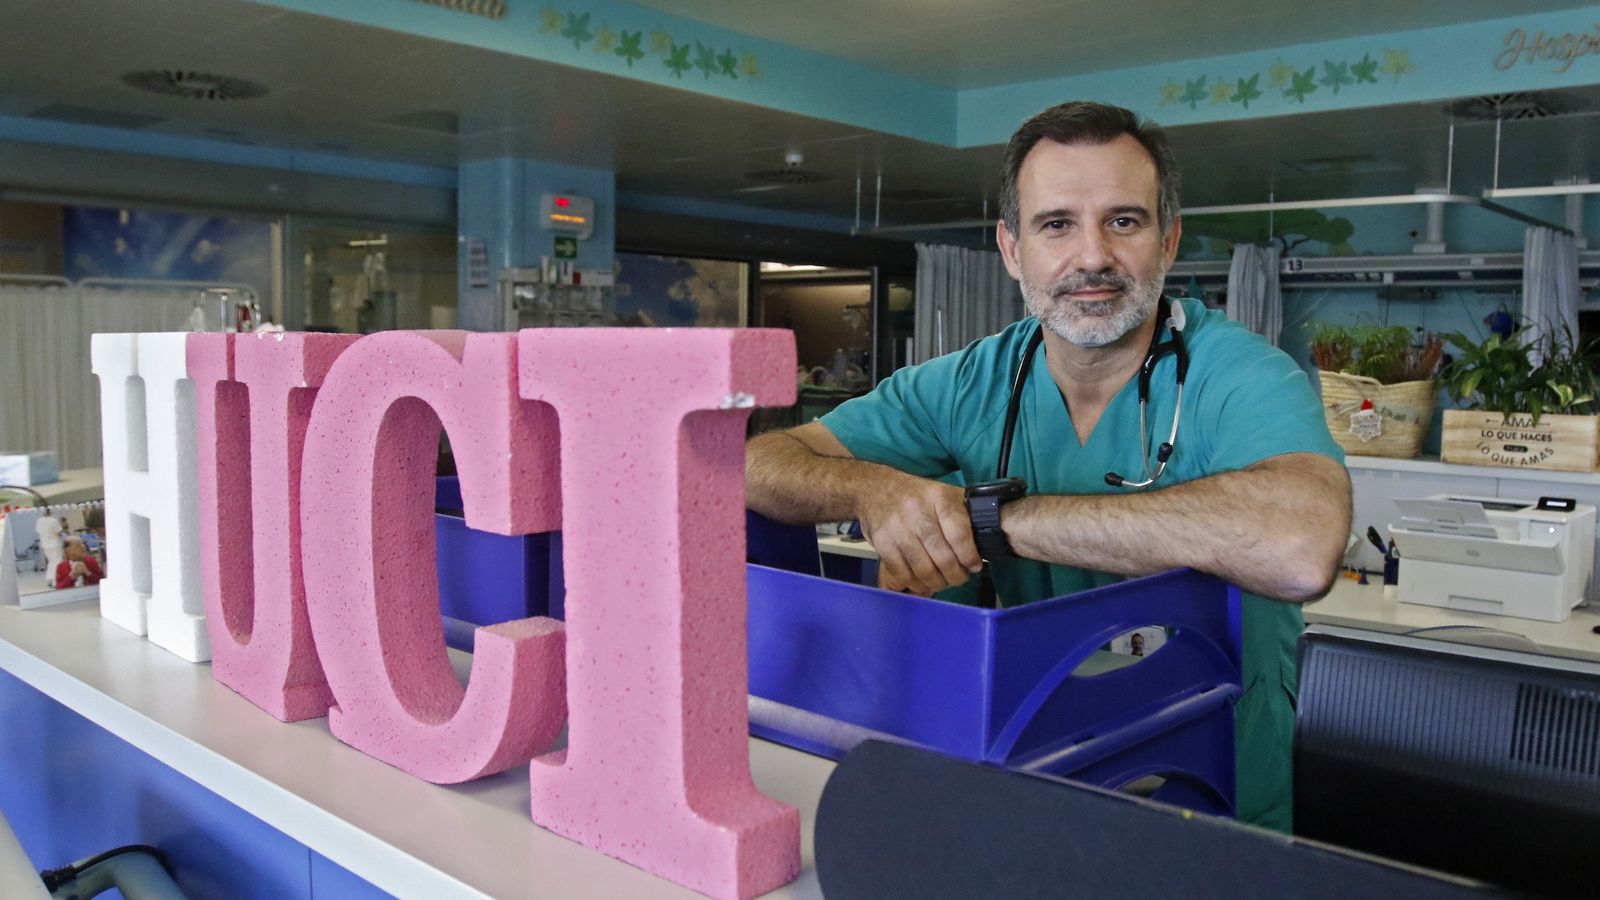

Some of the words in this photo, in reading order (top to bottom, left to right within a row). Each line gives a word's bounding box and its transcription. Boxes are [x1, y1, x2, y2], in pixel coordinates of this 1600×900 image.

[1288, 259, 1303, 271] 13
[1501, 417, 1536, 428] AMA
[1497, 431, 1517, 440] QUE
[1520, 433, 1552, 442] HACES
[1491, 453, 1515, 465] QUE
[1520, 447, 1554, 466] AMAS
